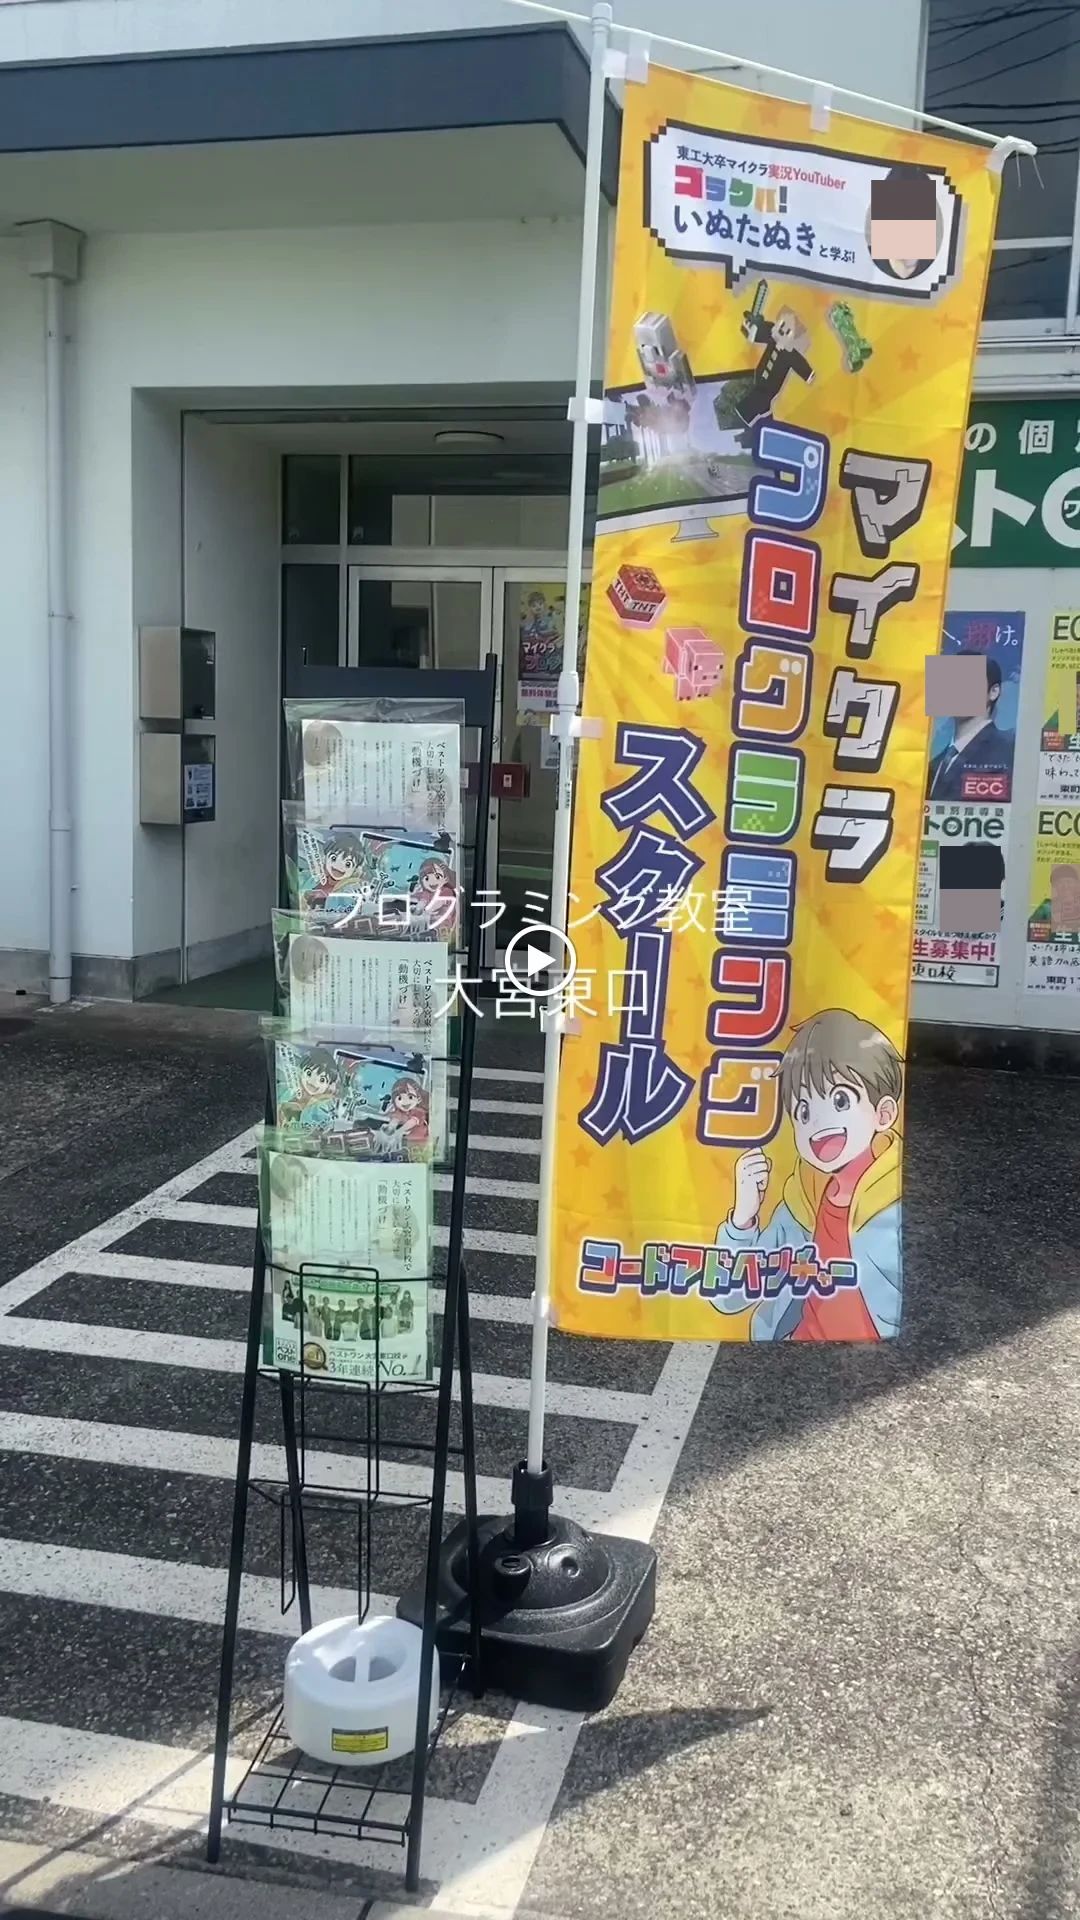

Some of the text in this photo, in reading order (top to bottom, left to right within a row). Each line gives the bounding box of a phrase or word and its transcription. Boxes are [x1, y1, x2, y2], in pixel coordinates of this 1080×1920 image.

[677, 146, 846, 190] 東工大卒マイクラ実況YouTuber
[964, 418, 1080, 455] の個
[632, 601, 656, 613] TNT
[811, 447, 932, 884] マイクラ
[696, 419, 830, 1148] プログラミング
[965, 781, 1004, 796] ECC
[578, 722, 717, 1147] スクール
[579, 1240, 859, 1299] コードアドベンチャー
